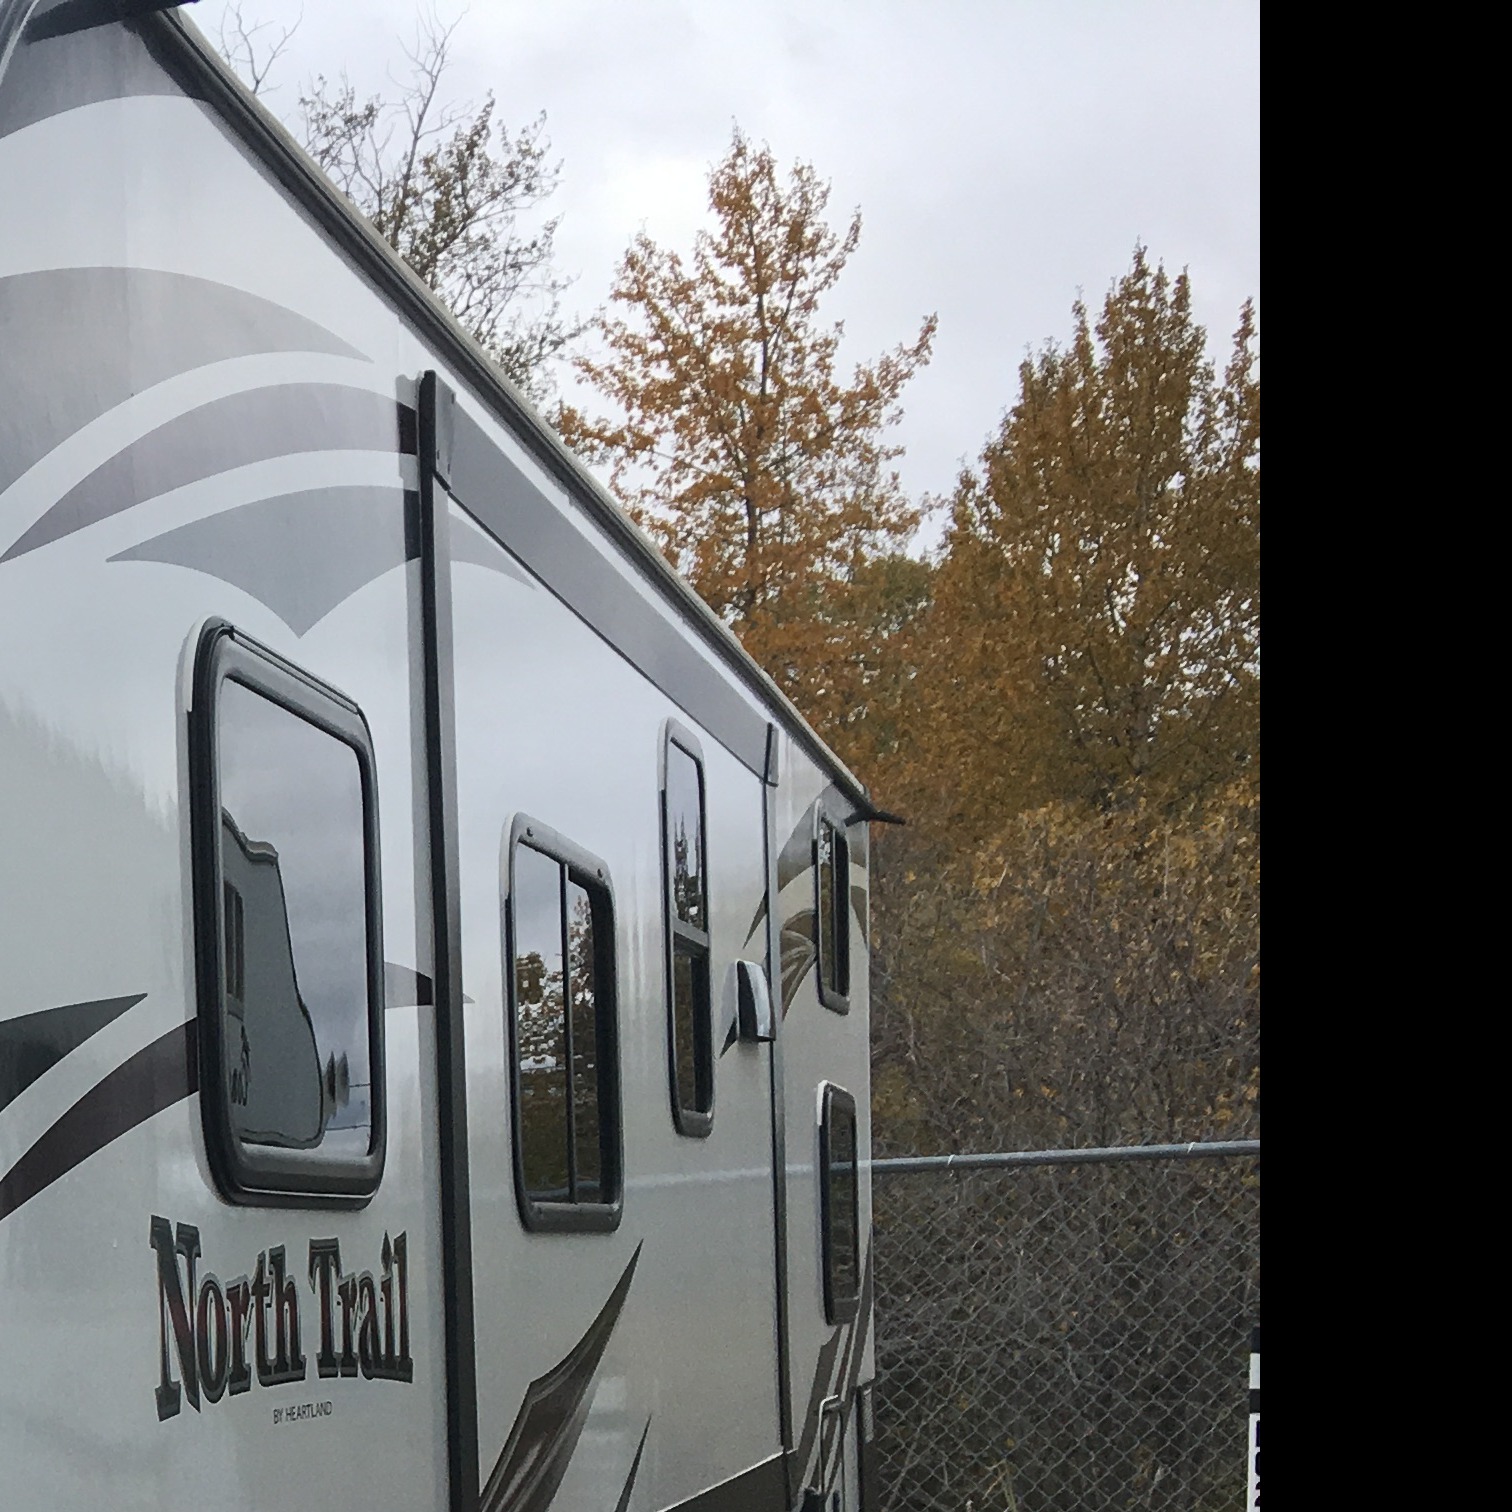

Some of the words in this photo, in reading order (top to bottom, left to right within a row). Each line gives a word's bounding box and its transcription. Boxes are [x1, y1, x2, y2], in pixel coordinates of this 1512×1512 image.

[149, 1214, 307, 1422] North
[308, 1229, 413, 1384] Trail
[273, 1408, 284, 1424] BY
[285, 1401, 333, 1421] HEARTLAND
